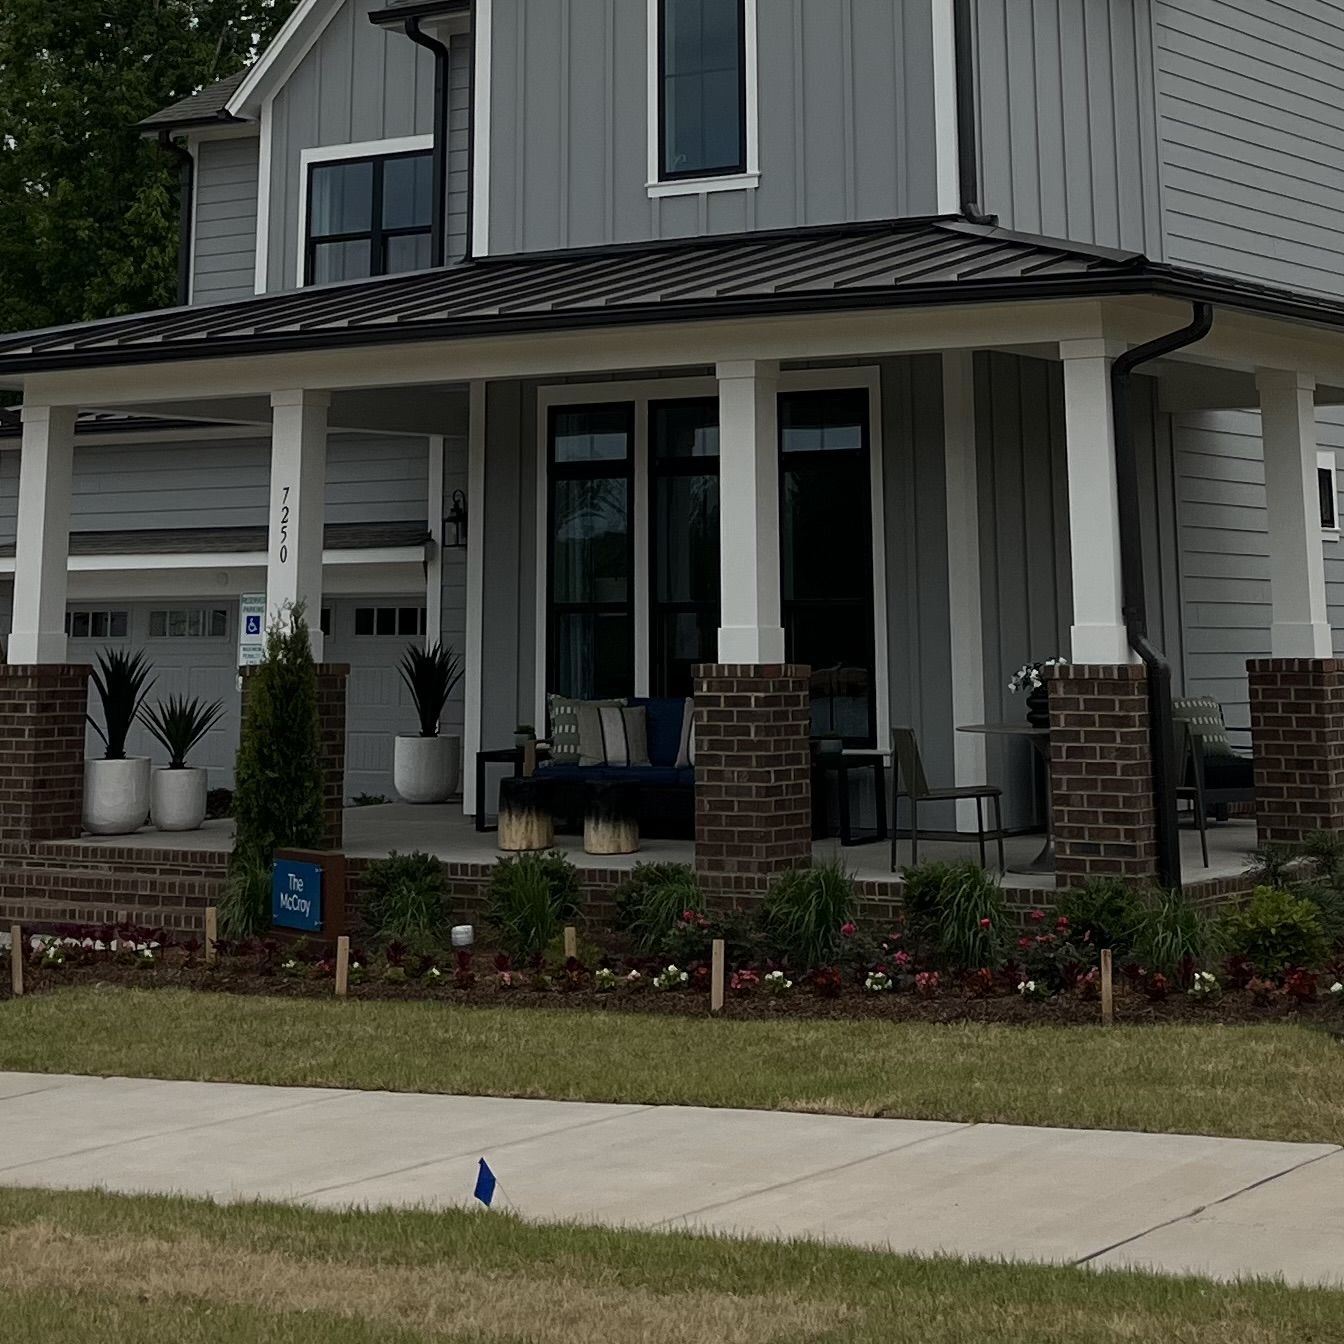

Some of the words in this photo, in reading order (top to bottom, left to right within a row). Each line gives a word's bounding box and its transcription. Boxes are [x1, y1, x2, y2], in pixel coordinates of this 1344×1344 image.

[280, 486, 290, 564] 7250
[287, 873, 304, 892] The
[280, 892, 312, 918] McCroy
